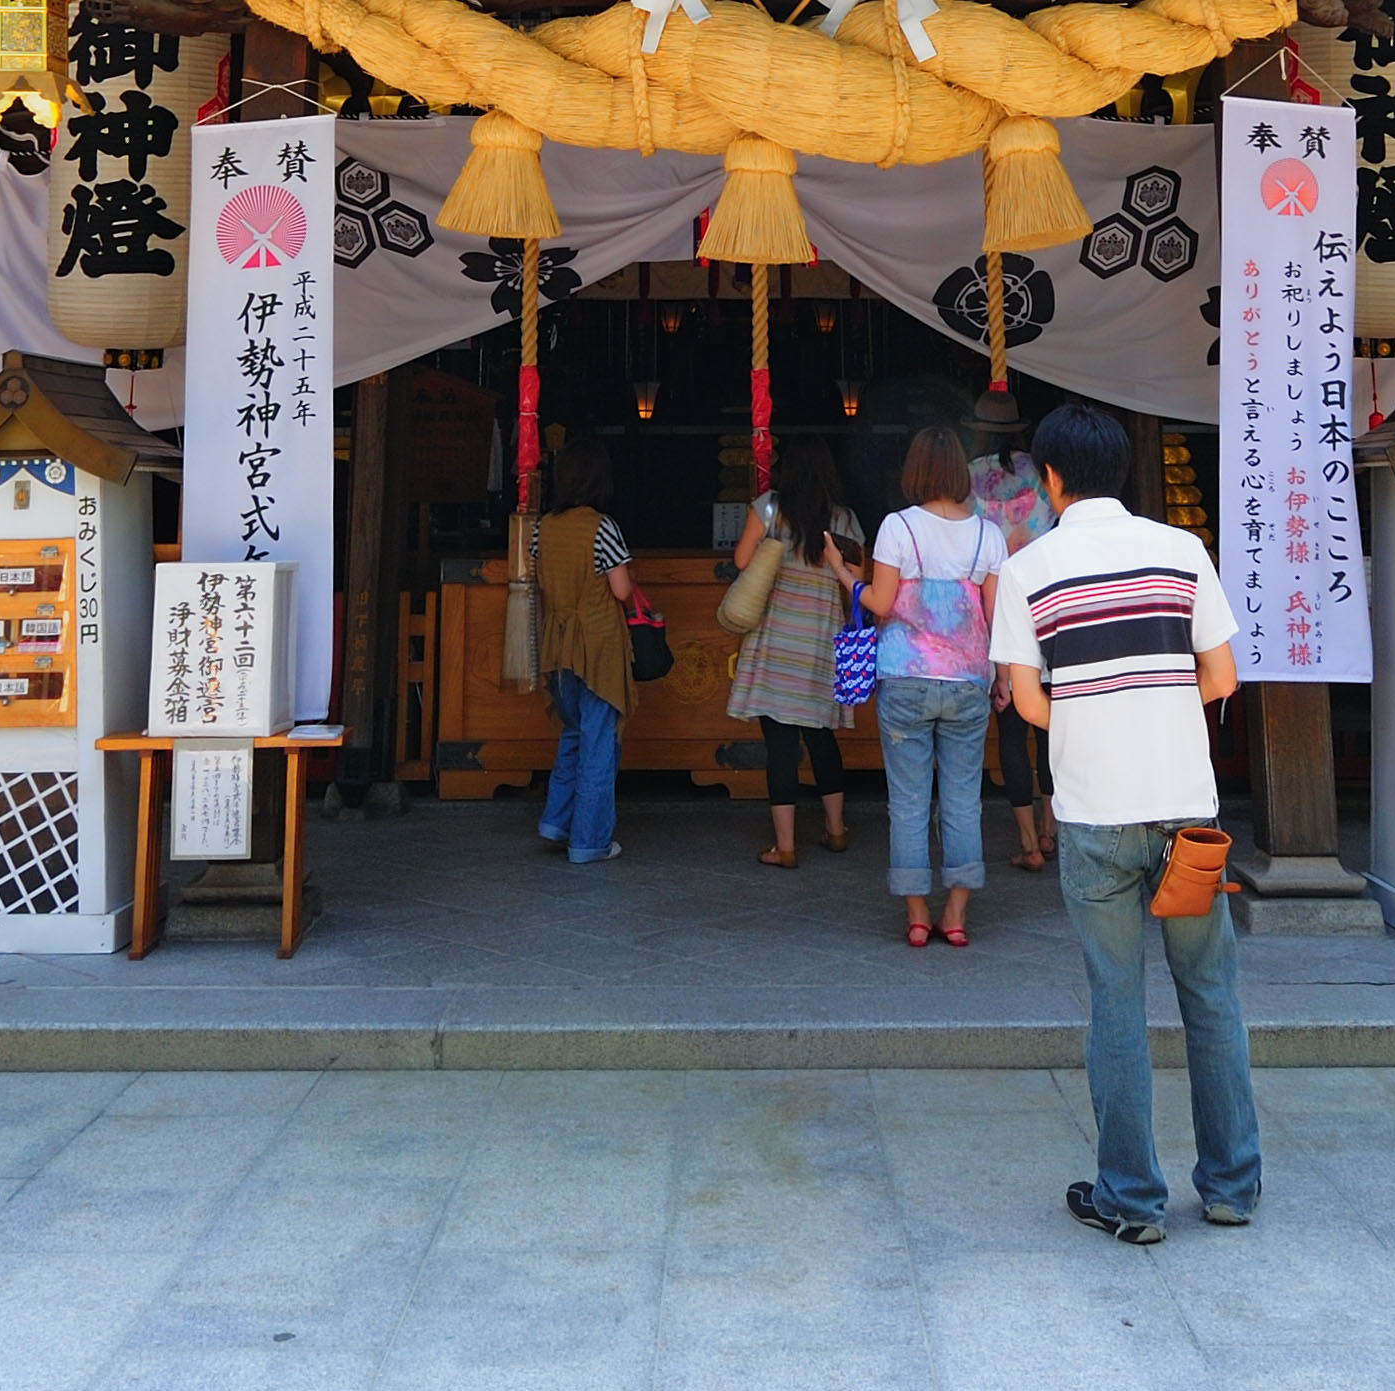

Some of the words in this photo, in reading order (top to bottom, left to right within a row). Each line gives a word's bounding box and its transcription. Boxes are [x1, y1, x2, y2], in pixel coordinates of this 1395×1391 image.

[55, 1, 187, 278] 御神燈
[209, 141, 317, 189] 奉賛
[1246, 122, 1332, 159] 奉賛
[291, 271, 317, 427] 平成二十五年
[1281, 261, 1307, 452] お祀りしましょう
[1313, 230, 1354, 603] 伝えよう日本のこころ
[1241, 259, 1266, 665] ありがとうと言える心を育てましょう
[0, 570, 34, 583] 日本語
[25, 621, 59, 634] 韓国語
[78, 495, 99, 645] おみくじ30円
[233, 574, 258, 668] 第六十二回
[1283, 467, 1313, 666] お伊勢様・氏神様
[164, 602, 196, 724] 浄財募金箱
[196, 571, 230, 724] 伊勢神宮御遷宮
